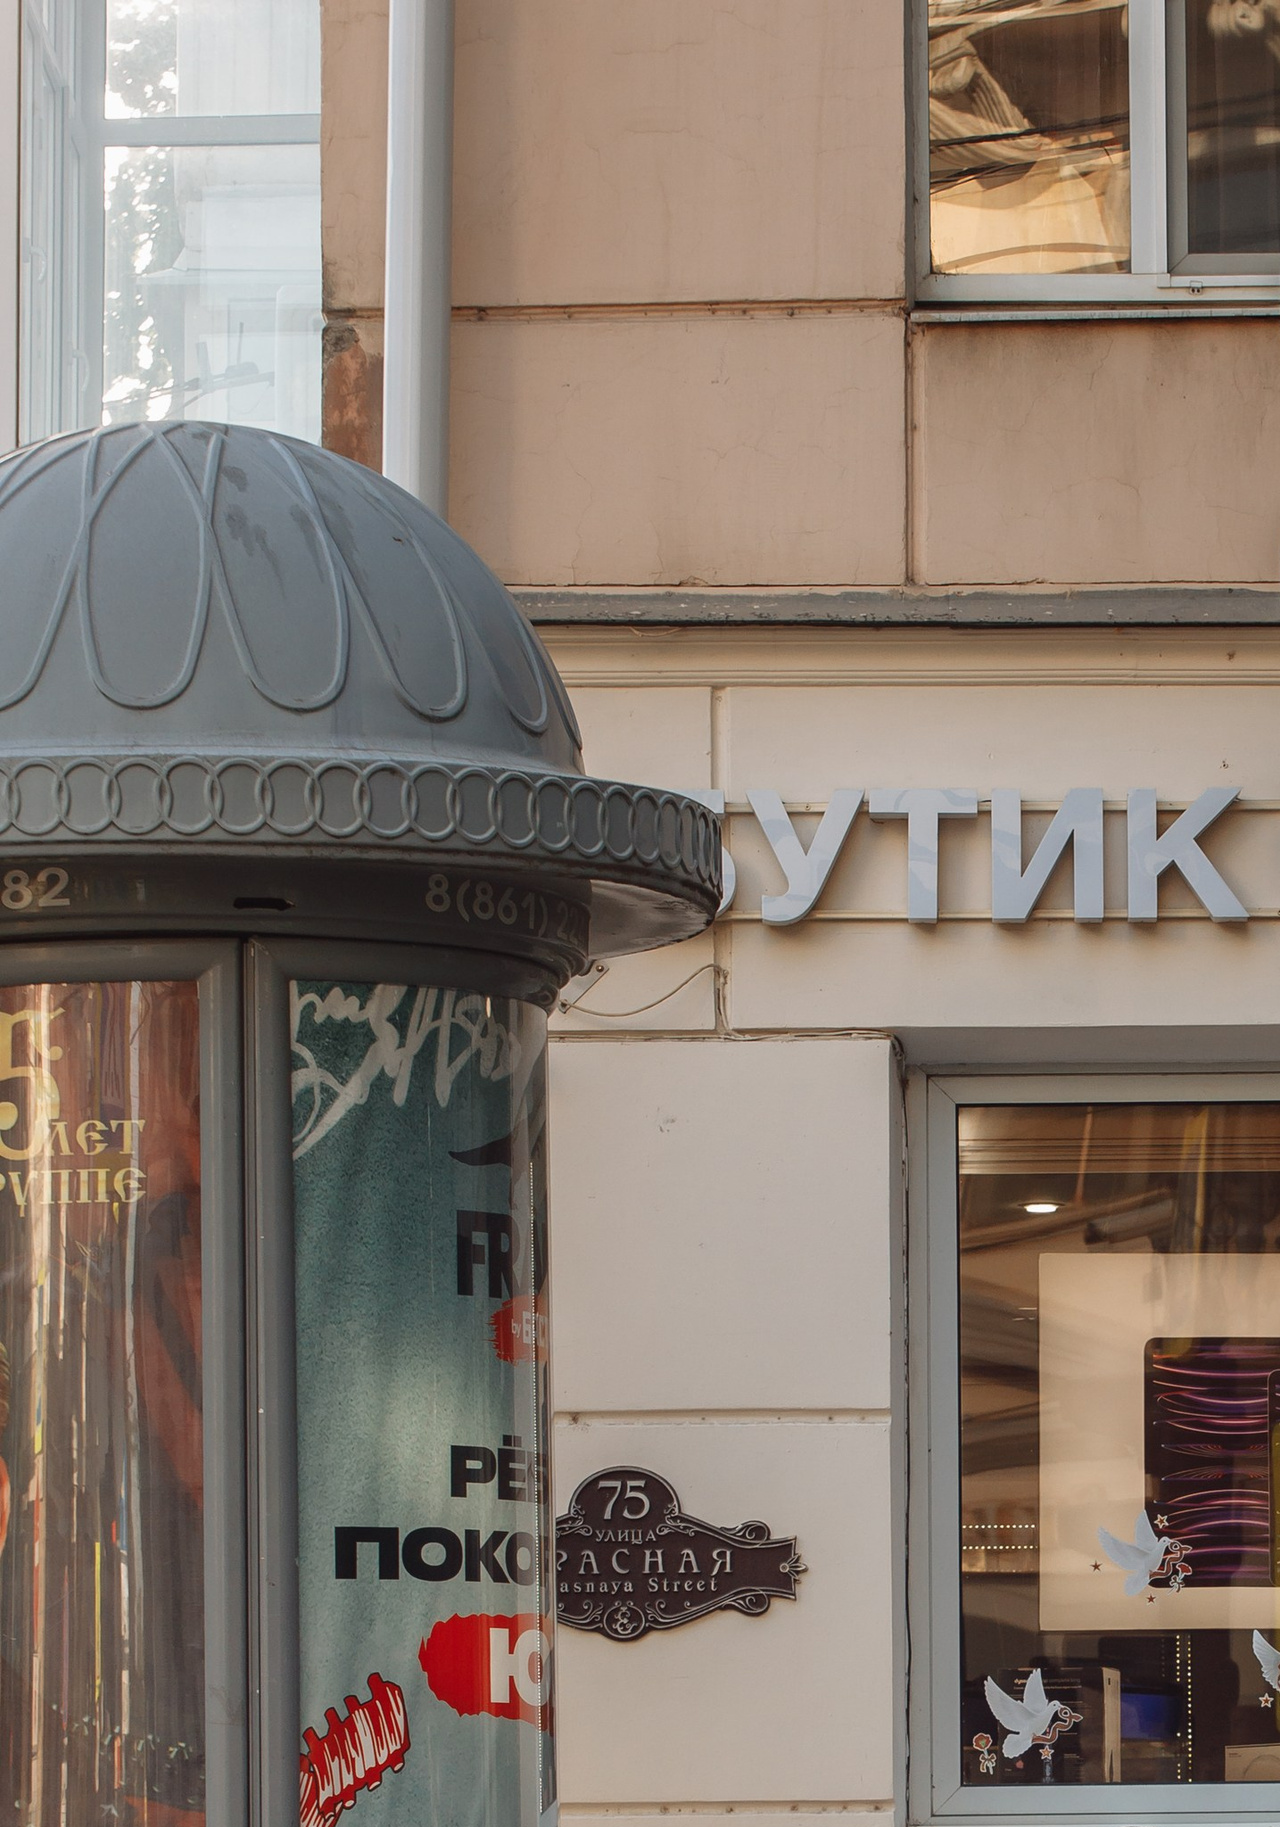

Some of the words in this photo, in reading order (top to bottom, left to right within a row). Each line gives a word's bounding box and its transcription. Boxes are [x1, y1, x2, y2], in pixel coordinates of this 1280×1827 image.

[597, 1480, 652, 1521] 75
[595, 1528, 658, 1545] УЛИЦА
[647, 1576, 719, 1594] Street
